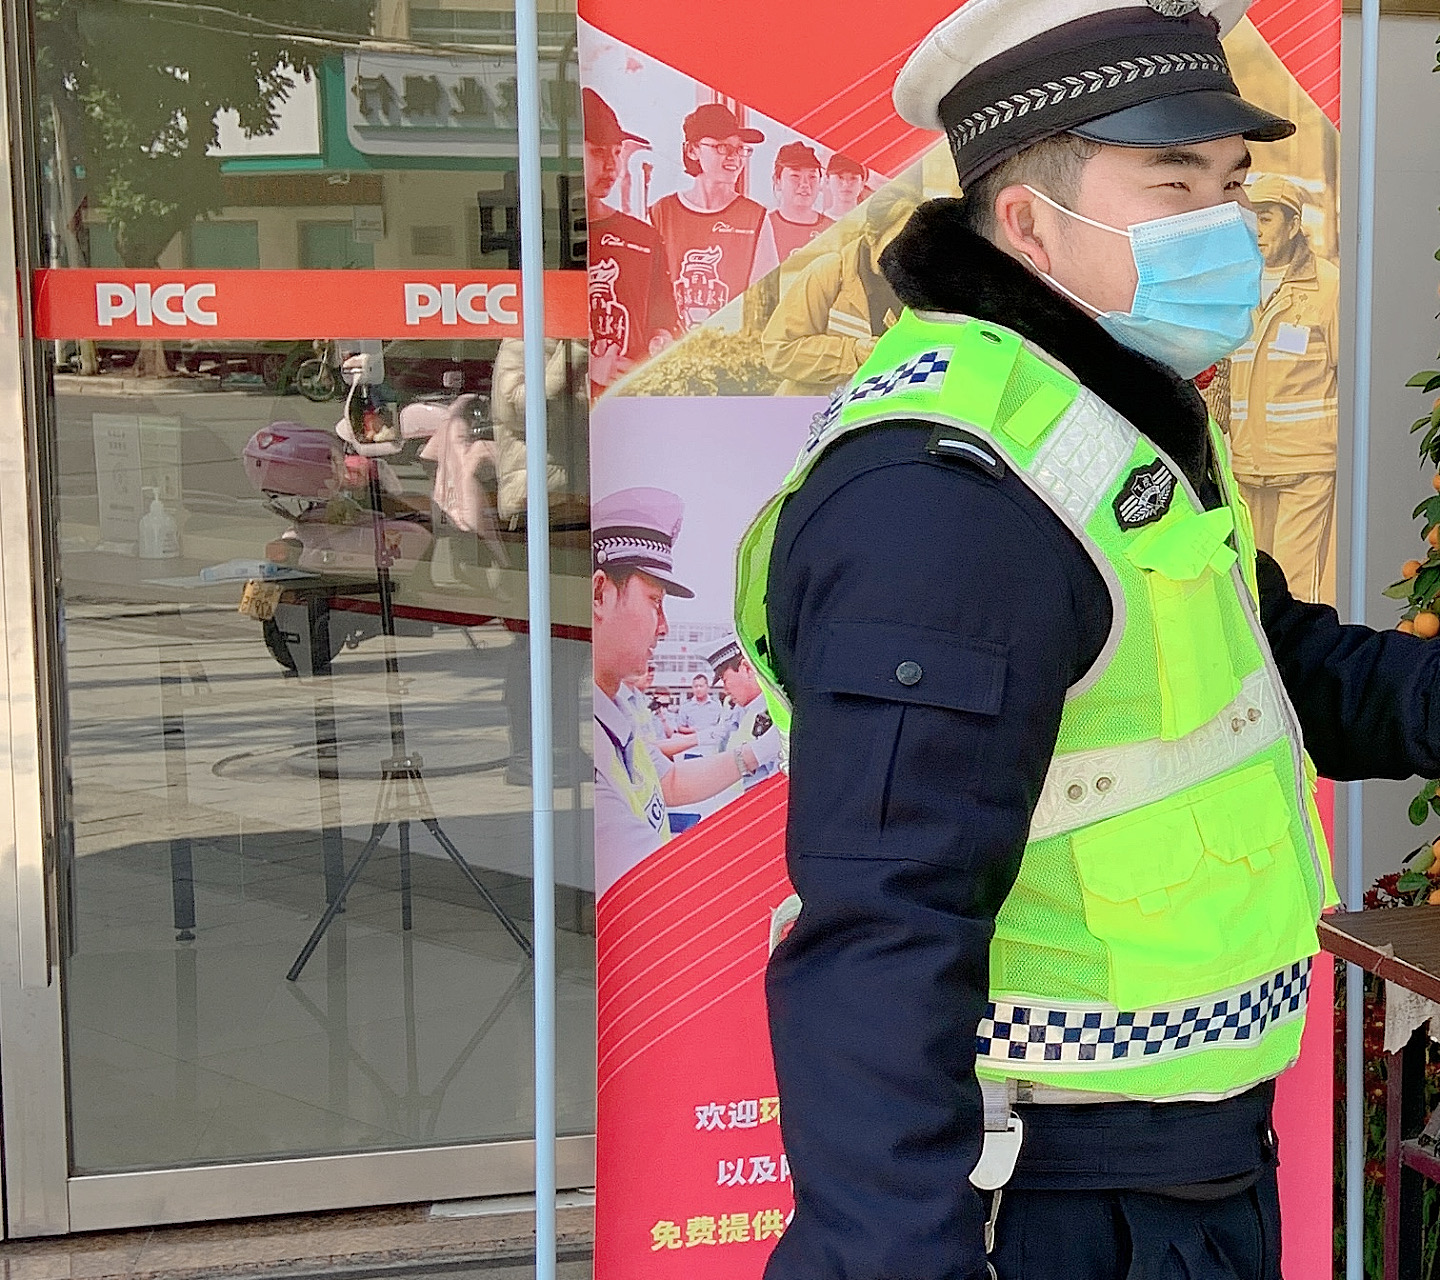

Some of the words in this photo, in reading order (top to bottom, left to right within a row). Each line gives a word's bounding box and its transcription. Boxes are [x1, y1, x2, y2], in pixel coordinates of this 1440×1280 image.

[96, 282, 218, 326] PICC
[404, 282, 518, 325] PICC
[650, 1209, 784, 1252] 免费提供
